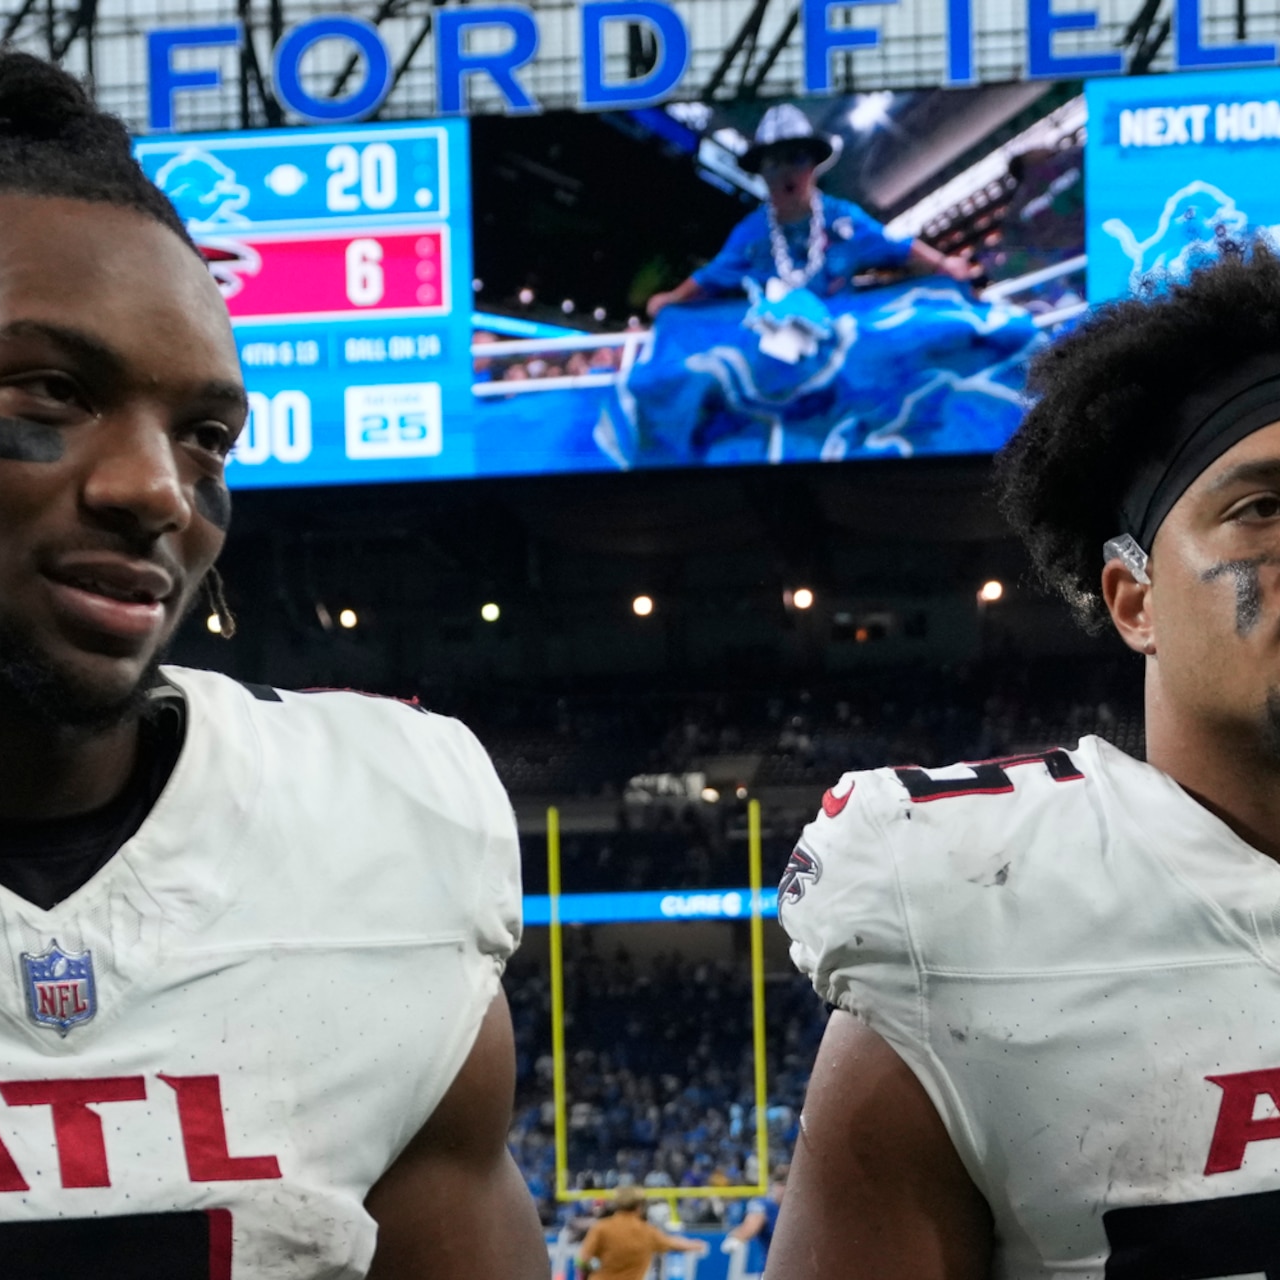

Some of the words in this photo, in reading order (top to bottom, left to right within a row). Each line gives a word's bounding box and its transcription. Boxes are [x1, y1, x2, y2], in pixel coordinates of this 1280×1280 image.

[145, 0, 690, 131] FORD
[1119, 104, 1211, 147] NEXT
[325, 143, 398, 212] 20
[344, 238, 384, 306] 6
[360, 412, 428, 443] 25
[37, 982, 88, 1019] NFL
